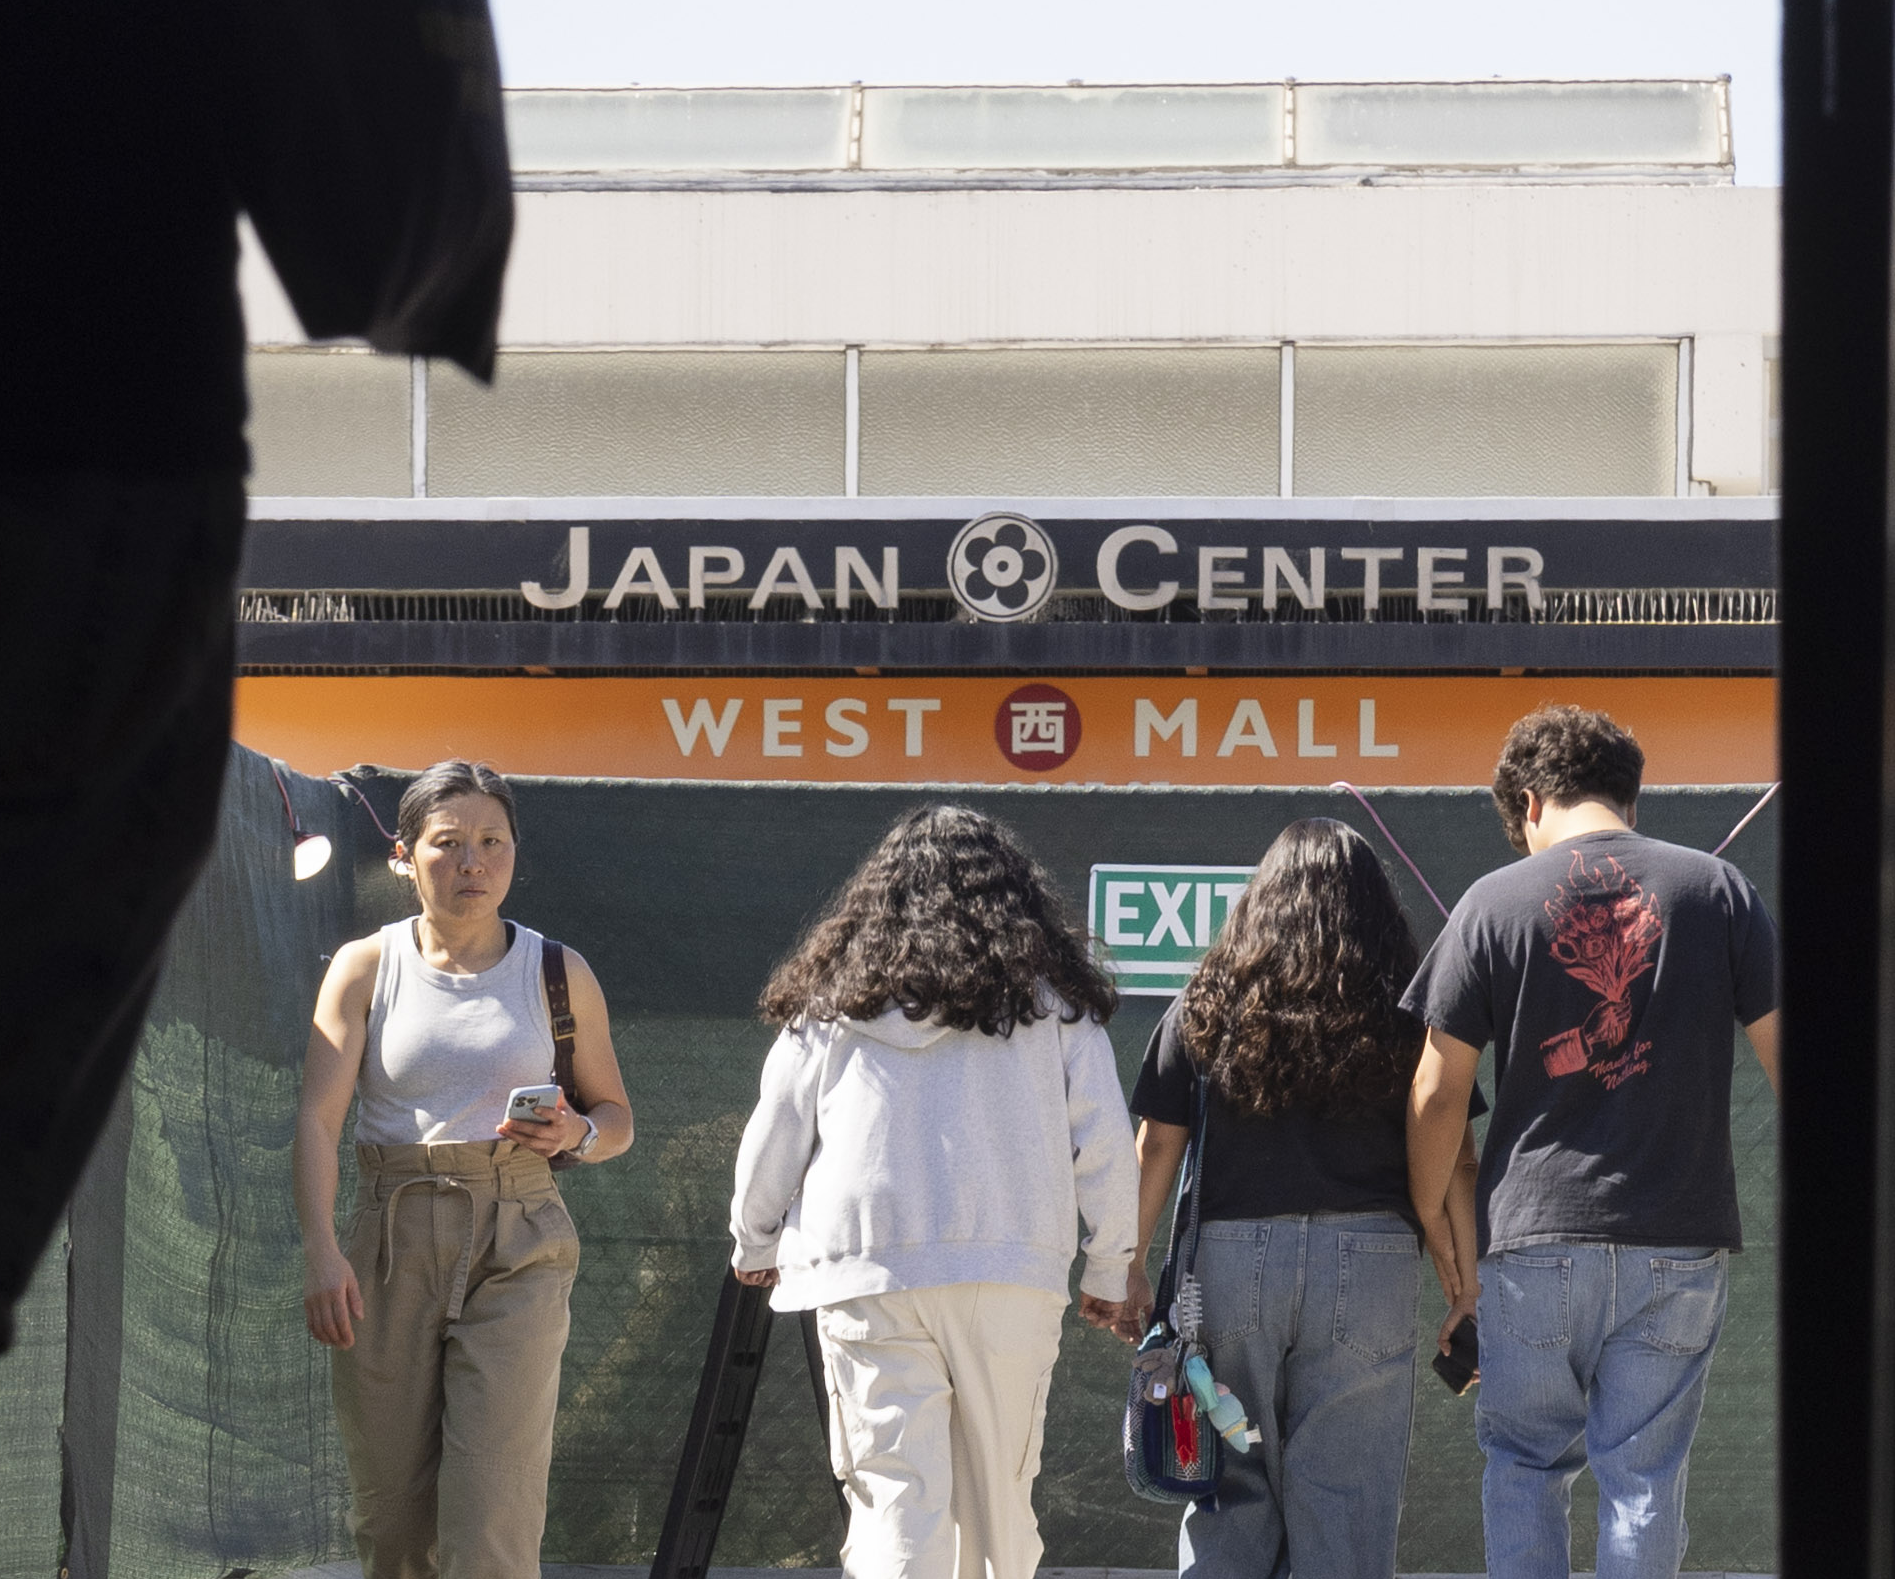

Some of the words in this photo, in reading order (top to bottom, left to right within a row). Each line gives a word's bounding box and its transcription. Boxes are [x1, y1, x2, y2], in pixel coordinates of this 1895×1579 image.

[520, 526, 900, 611] JAPAN
[1097, 524, 1545, 612] CENTER
[662, 697, 941, 758] WEST
[1010, 701, 1066, 755] 西
[1133, 697, 1400, 758] MALL
[1634, 1041, 1653, 1060] for
